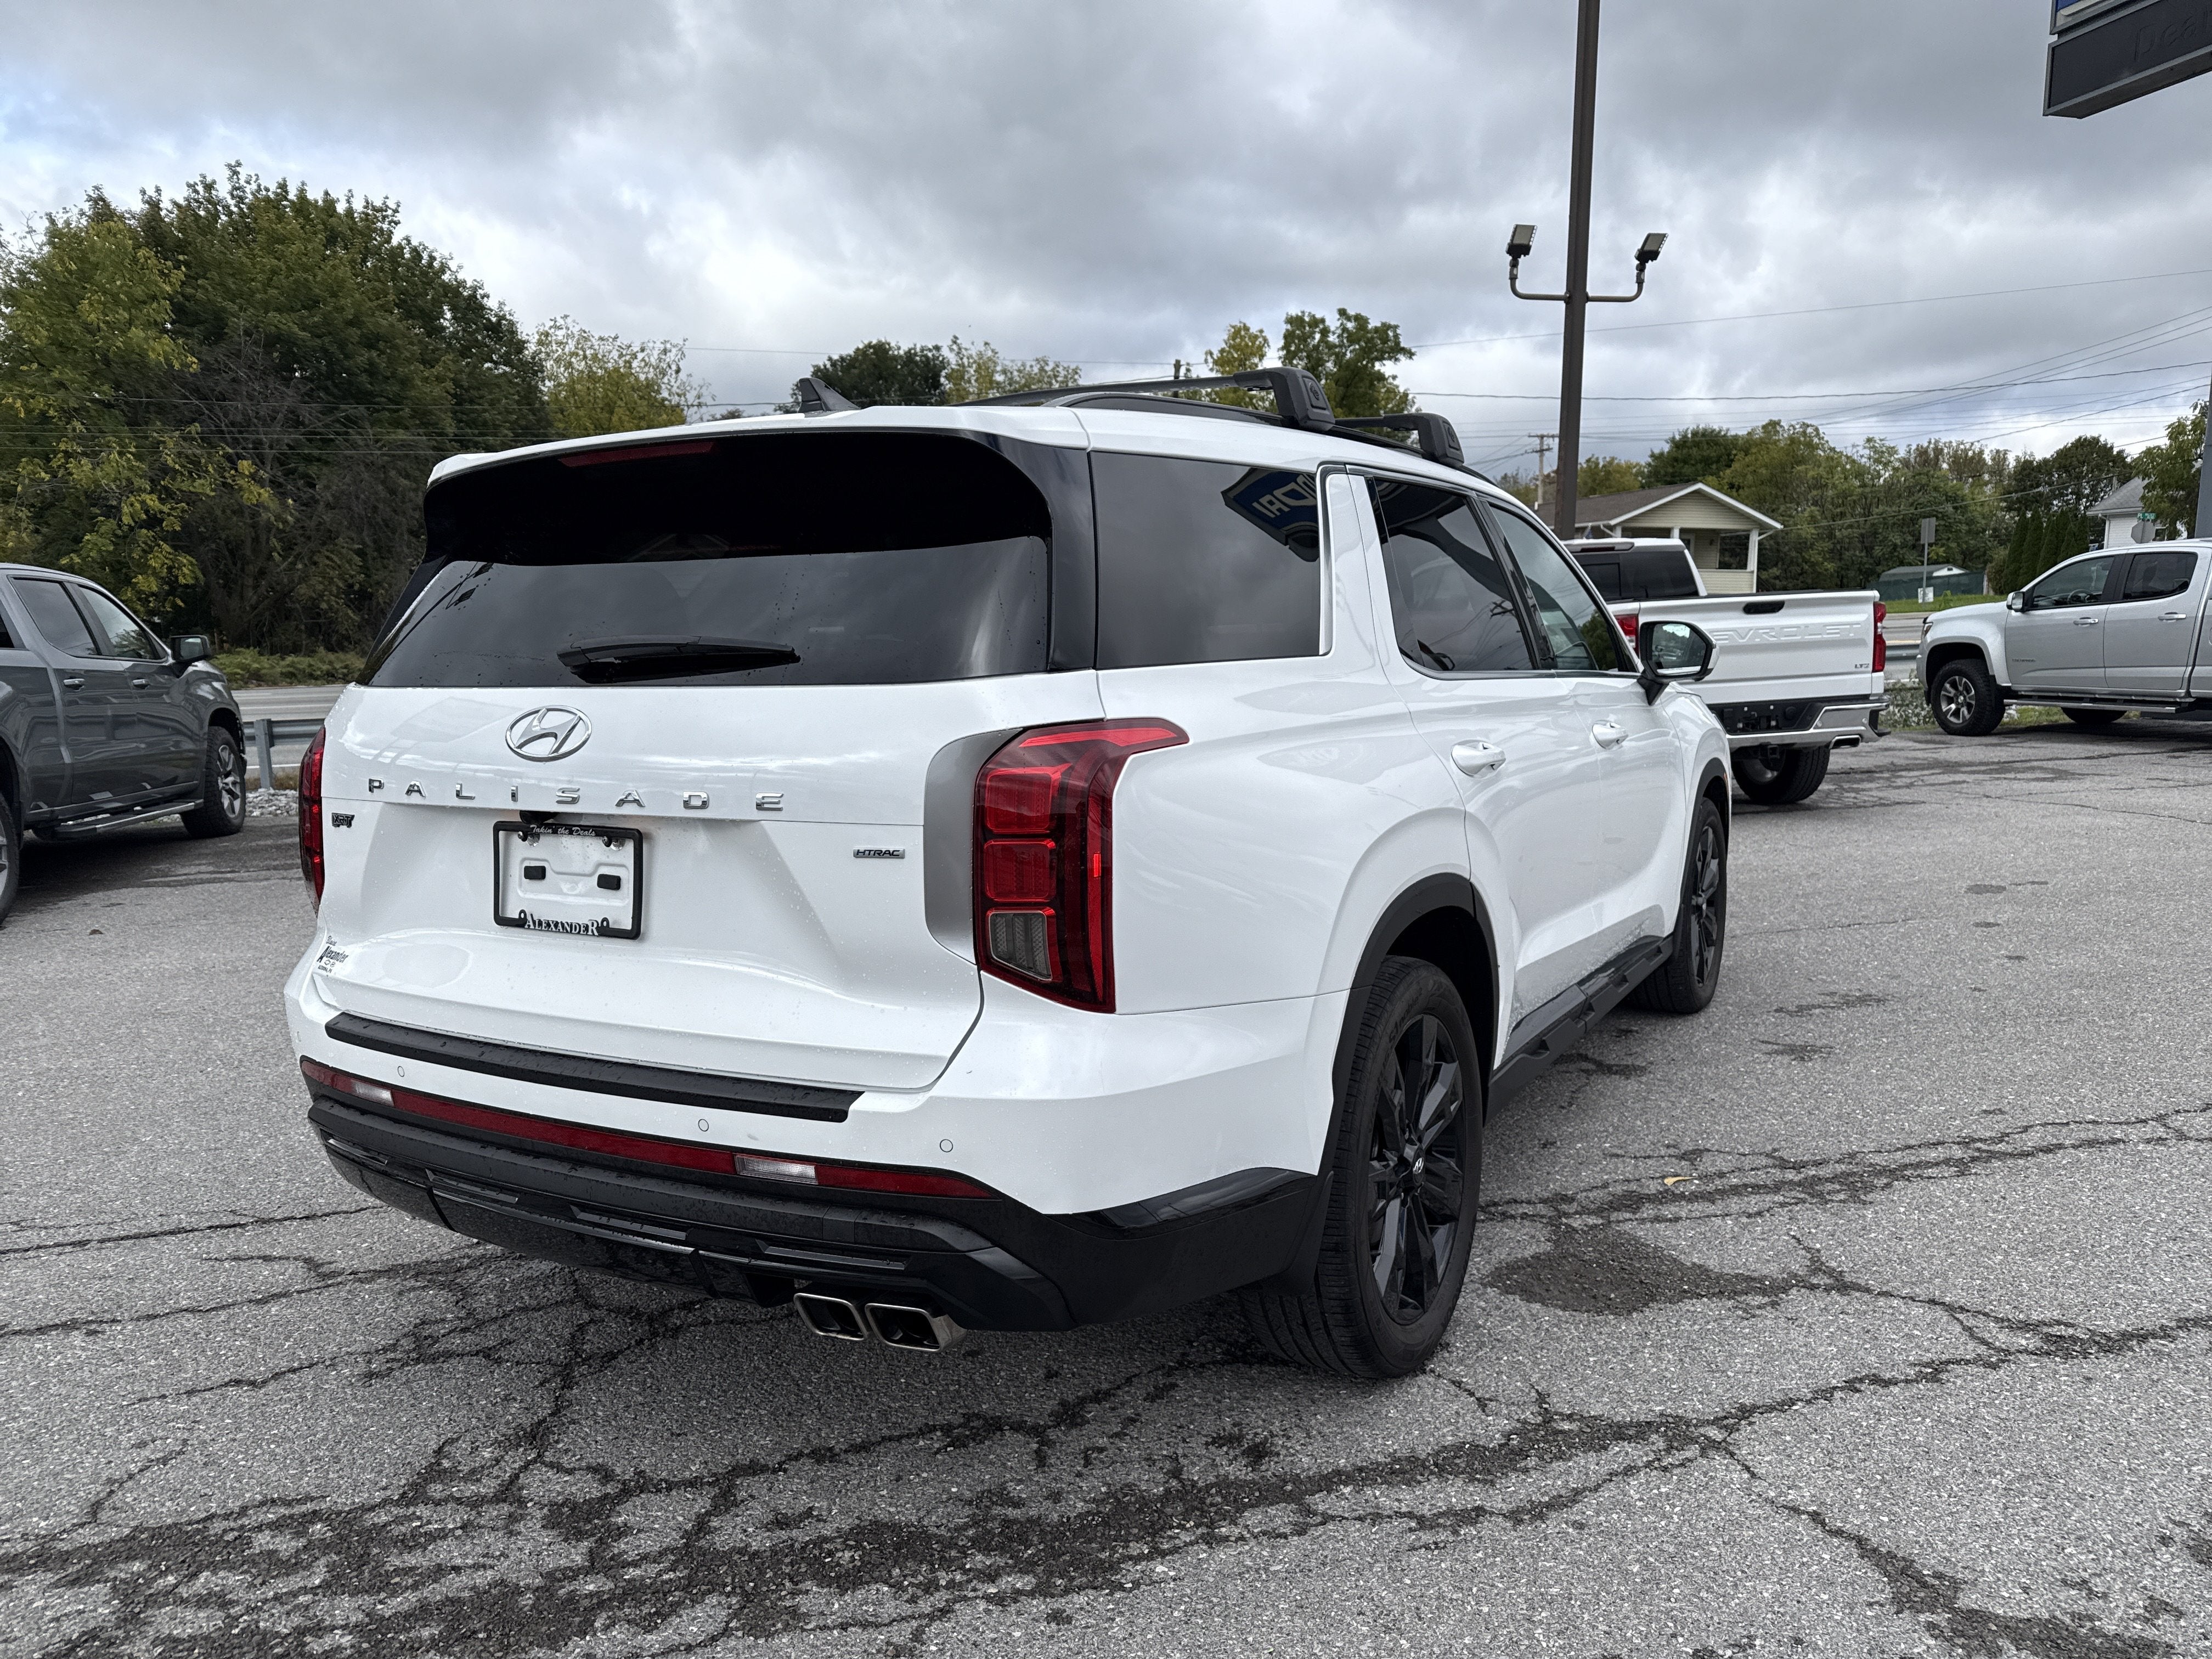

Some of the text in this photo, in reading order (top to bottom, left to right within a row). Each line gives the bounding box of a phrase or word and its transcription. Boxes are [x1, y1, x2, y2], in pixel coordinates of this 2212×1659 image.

[1709, 623, 1861, 644] EVROLET
[368, 777, 783, 812] PALISADE
[331, 813, 353, 827] XRT
[557, 826, 570, 834] the
[572, 827, 596, 837] Deals
[524, 913, 599, 936] ALEXANDER
[316, 945, 349, 963] Alexander
